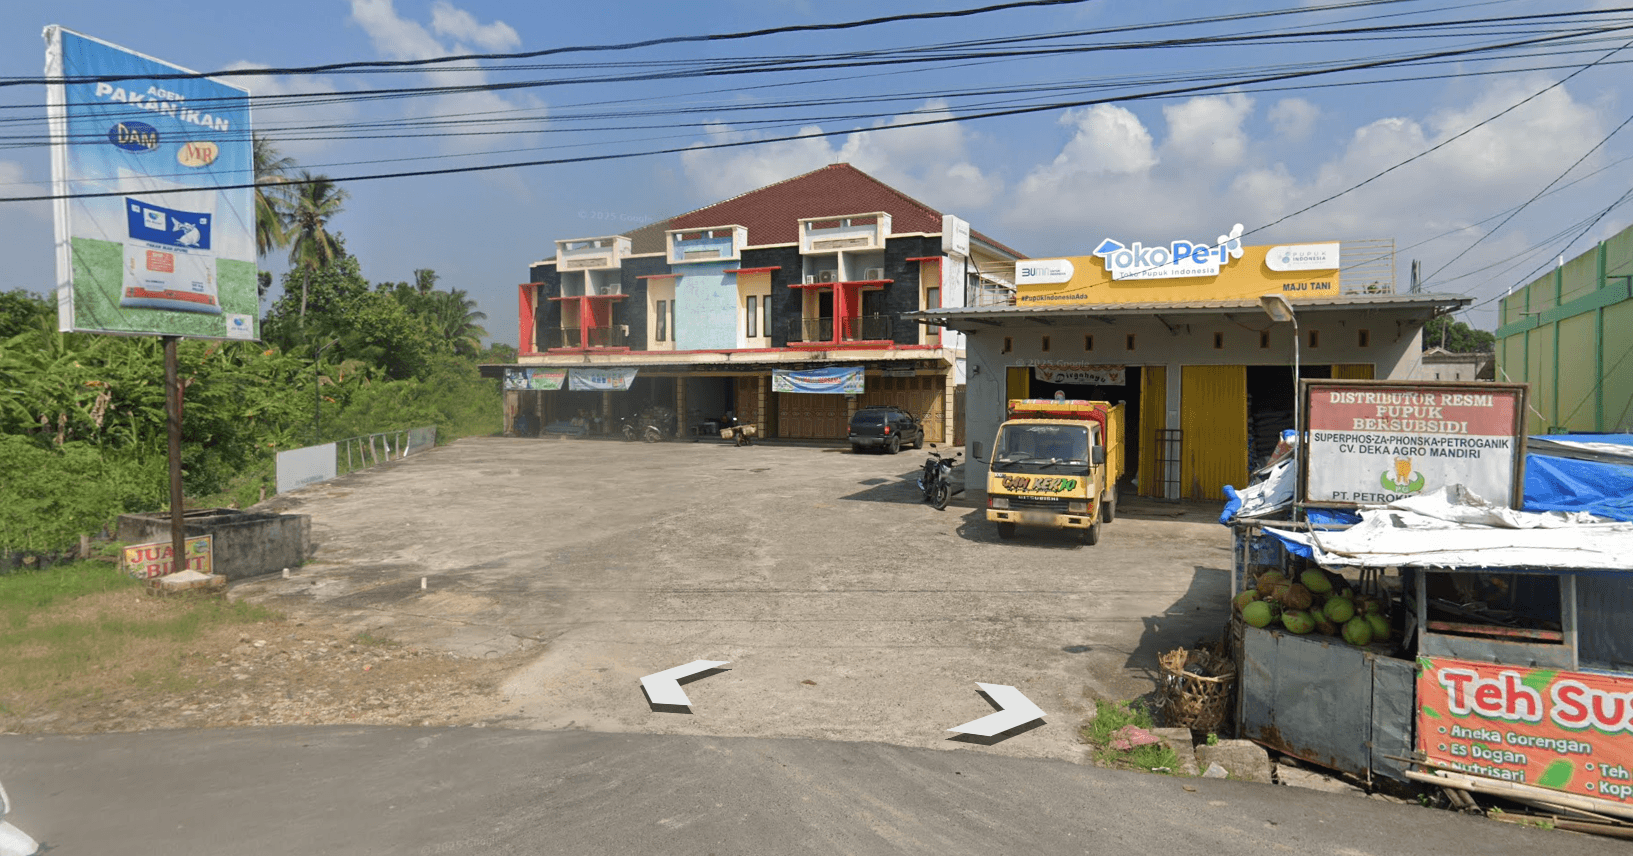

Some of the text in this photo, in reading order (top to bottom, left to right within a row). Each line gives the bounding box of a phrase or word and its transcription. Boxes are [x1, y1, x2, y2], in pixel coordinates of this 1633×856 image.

[147, 86, 185, 104] AGEN
[95, 82, 229, 132] PAKAN IKAN
[118, 123, 158, 149] DAM
[185, 142, 214, 163] MR
[1142, 269, 1168, 277] Pupuk
[1171, 267, 1214, 276] Indonesia
[1283, 281, 1331, 291] MAJU TANI
[1330, 392, 1493, 407] DISTRIBUTOR RESMI
[1376, 405, 1443, 419] PUPUK
[1339, 444, 1481, 458] CV. DEKA AGRO MANDIRI
[1332, 491, 1349, 500] PT.
[1441, 670, 1633, 728] Teh Su
[1451, 725, 1592, 754] Aneka Gorengan
[1472, 745, 1526, 764] Dogan
[1599, 763, 1629, 779] Teh
